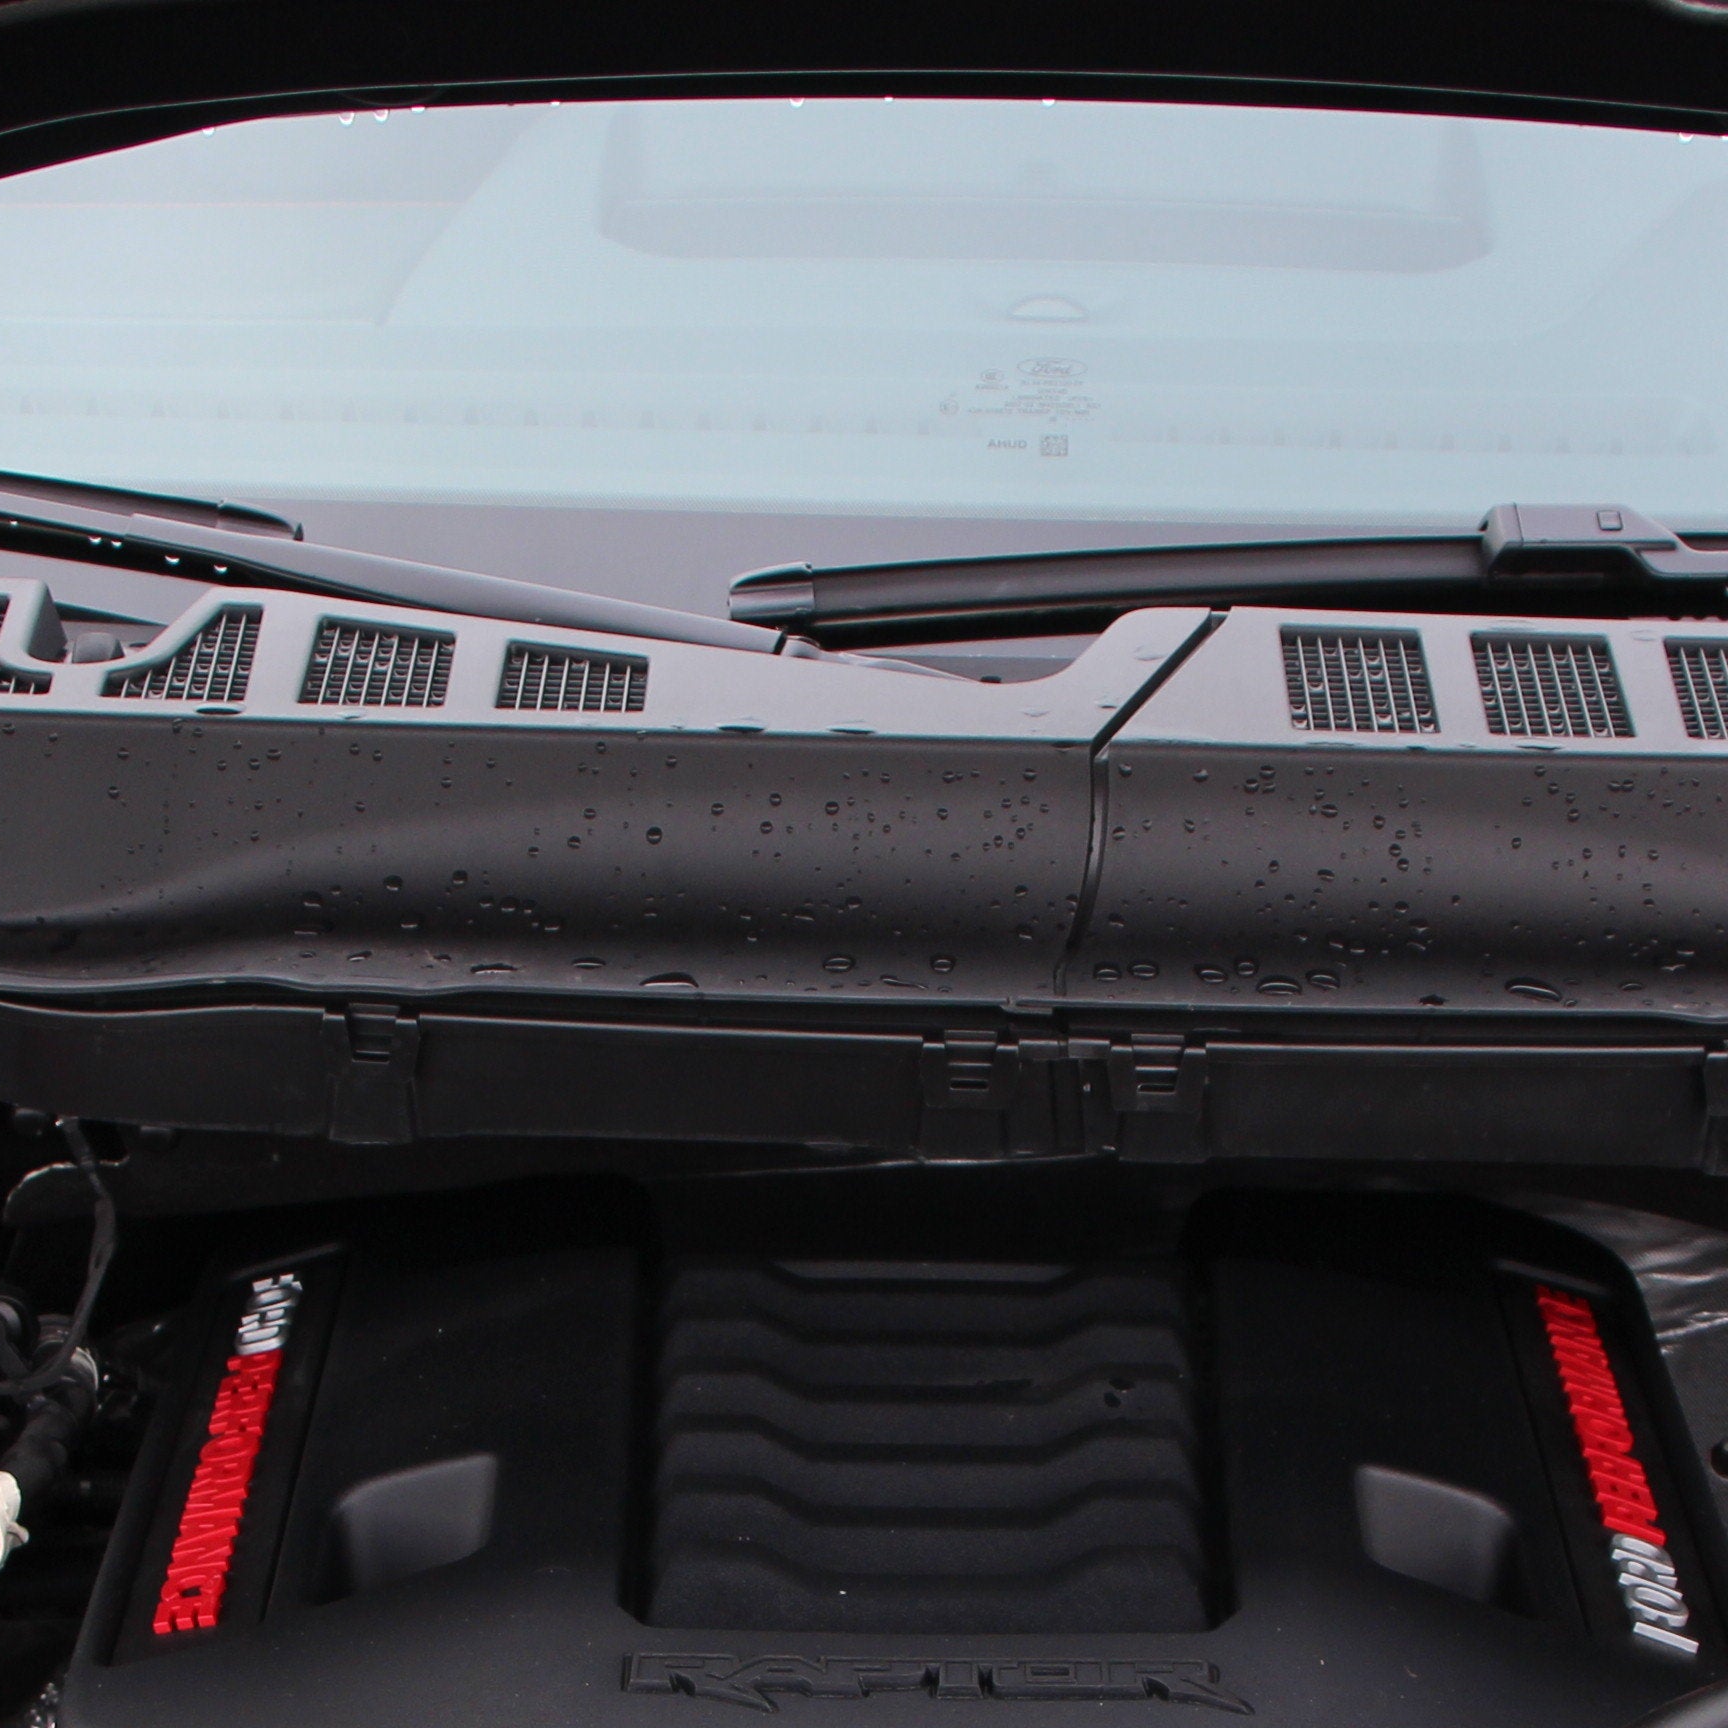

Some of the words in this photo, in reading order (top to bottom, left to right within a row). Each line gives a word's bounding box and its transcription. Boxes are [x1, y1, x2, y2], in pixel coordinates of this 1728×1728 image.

[987, 438, 1028, 449] AHUD
[234, 1272, 303, 1355] FORD
[1535, 1284, 1667, 1547] PERFORMANCE
[152, 1350, 284, 1636] PERFORMANCE
[1610, 1532, 1701, 1655] FORD
[621, 1653, 1255, 1715] RAPTOR
